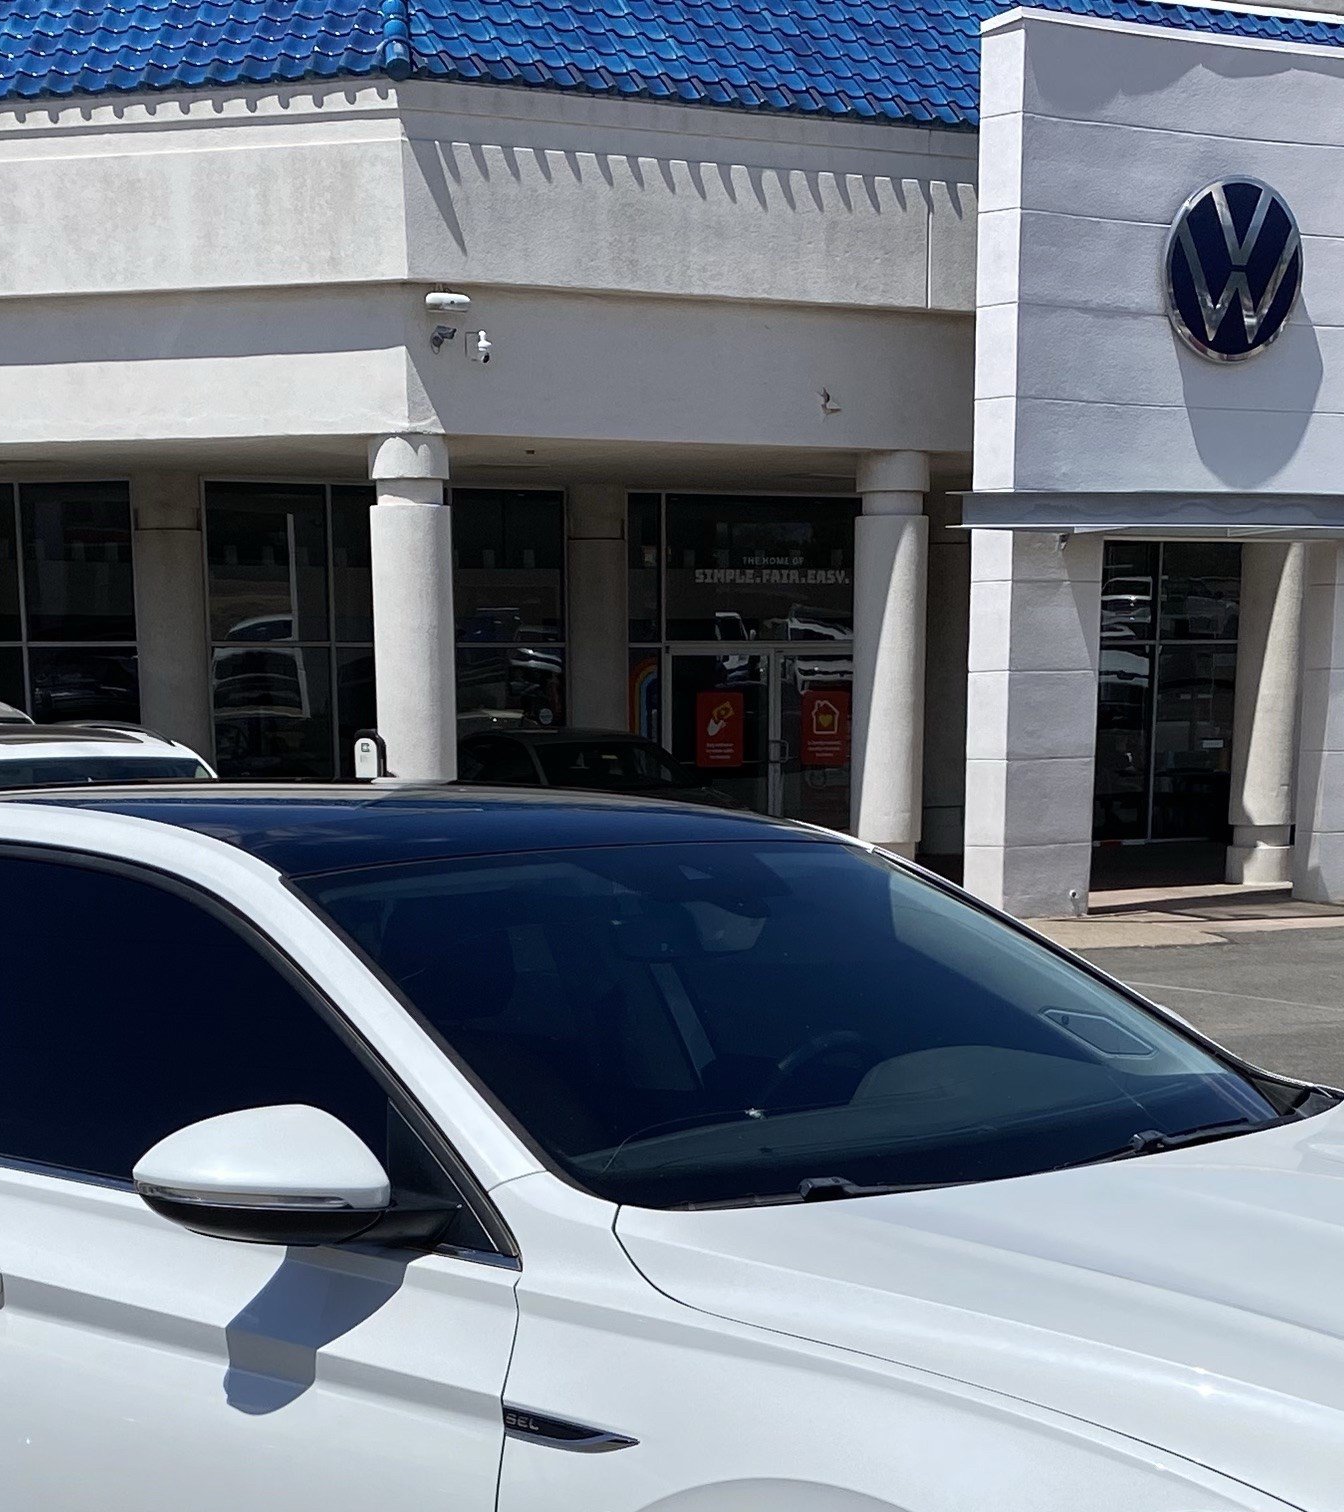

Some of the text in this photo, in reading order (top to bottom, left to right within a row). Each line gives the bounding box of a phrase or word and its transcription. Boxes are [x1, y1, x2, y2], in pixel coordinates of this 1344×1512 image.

[742, 556, 805, 565] THE HOME OF
[505, 1413, 539, 1431] SEL
